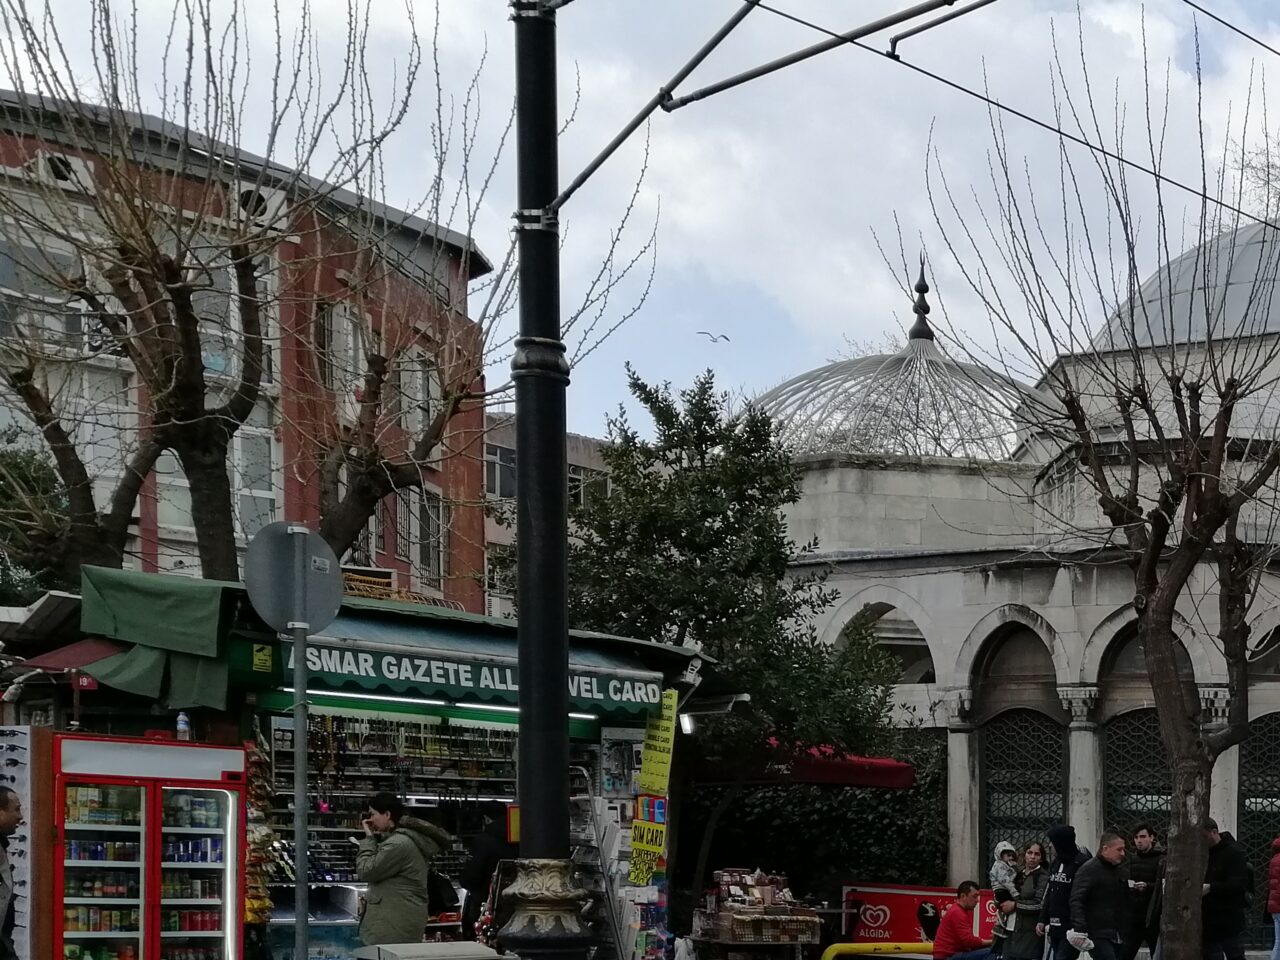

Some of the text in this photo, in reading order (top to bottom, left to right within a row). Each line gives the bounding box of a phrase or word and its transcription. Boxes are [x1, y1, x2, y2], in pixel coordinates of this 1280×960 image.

[381, 655, 473, 688] GAZETE
[479, 666, 519, 691] ALL
[608, 679, 661, 704] CARD
[633, 825, 664, 847] SIM CARD
